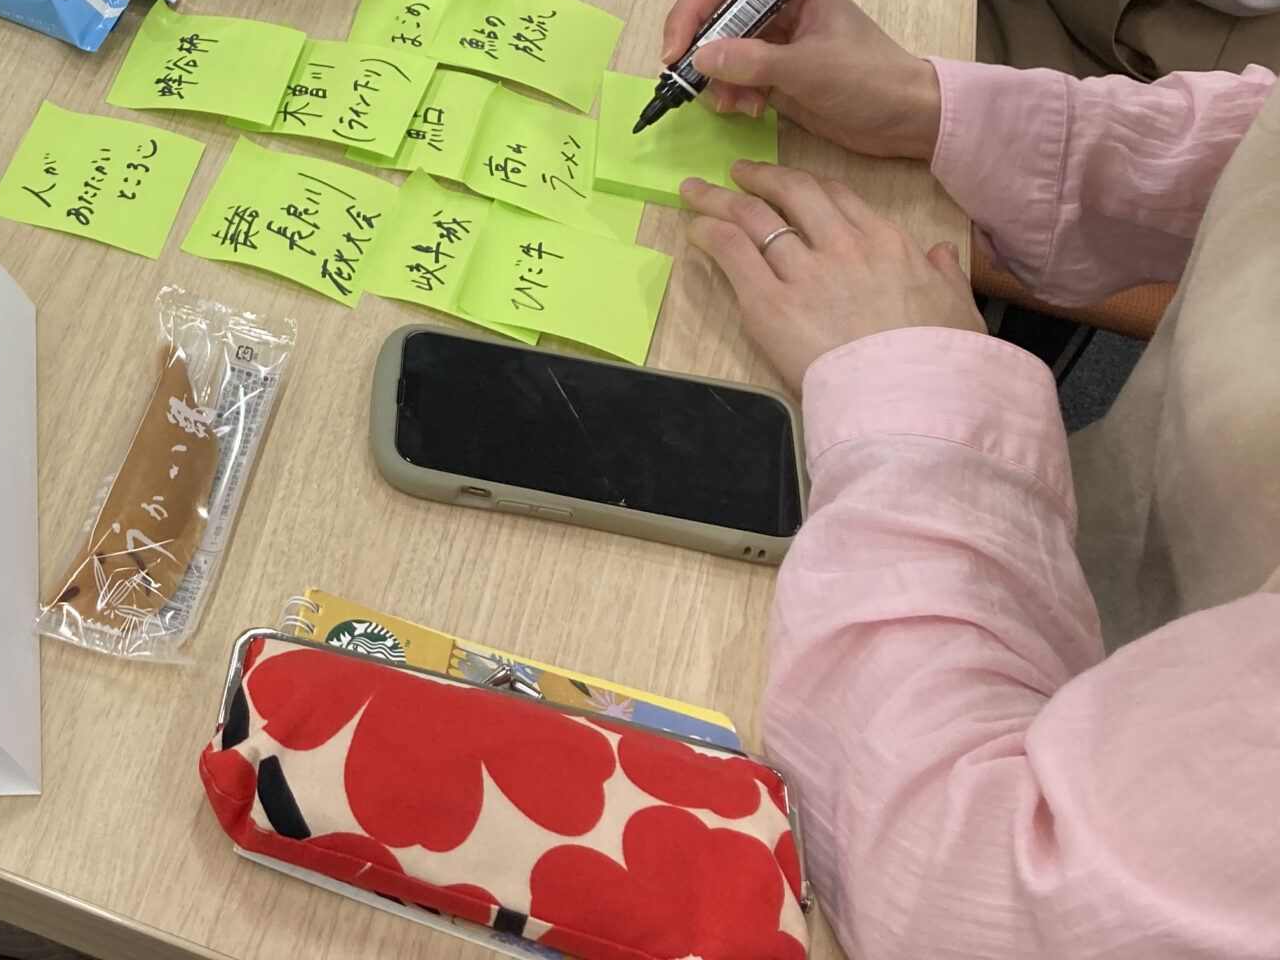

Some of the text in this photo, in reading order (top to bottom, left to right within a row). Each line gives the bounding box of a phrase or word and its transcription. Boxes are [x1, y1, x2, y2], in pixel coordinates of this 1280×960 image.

[459, 16, 507, 61] 鮎の
[512, 8, 557, 62] 放流
[21, 153, 57, 208] 人が
[66, 148, 111, 225] あたたかい
[483, 144, 528, 187] 高山
[549, 134, 583, 198] ラーメン
[266, 170, 356, 255] 長良川
[319, 206, 381, 294] 花火大会
[410, 210, 474, 291] 岐阜城
[513, 242, 564, 312] ひだ牛
